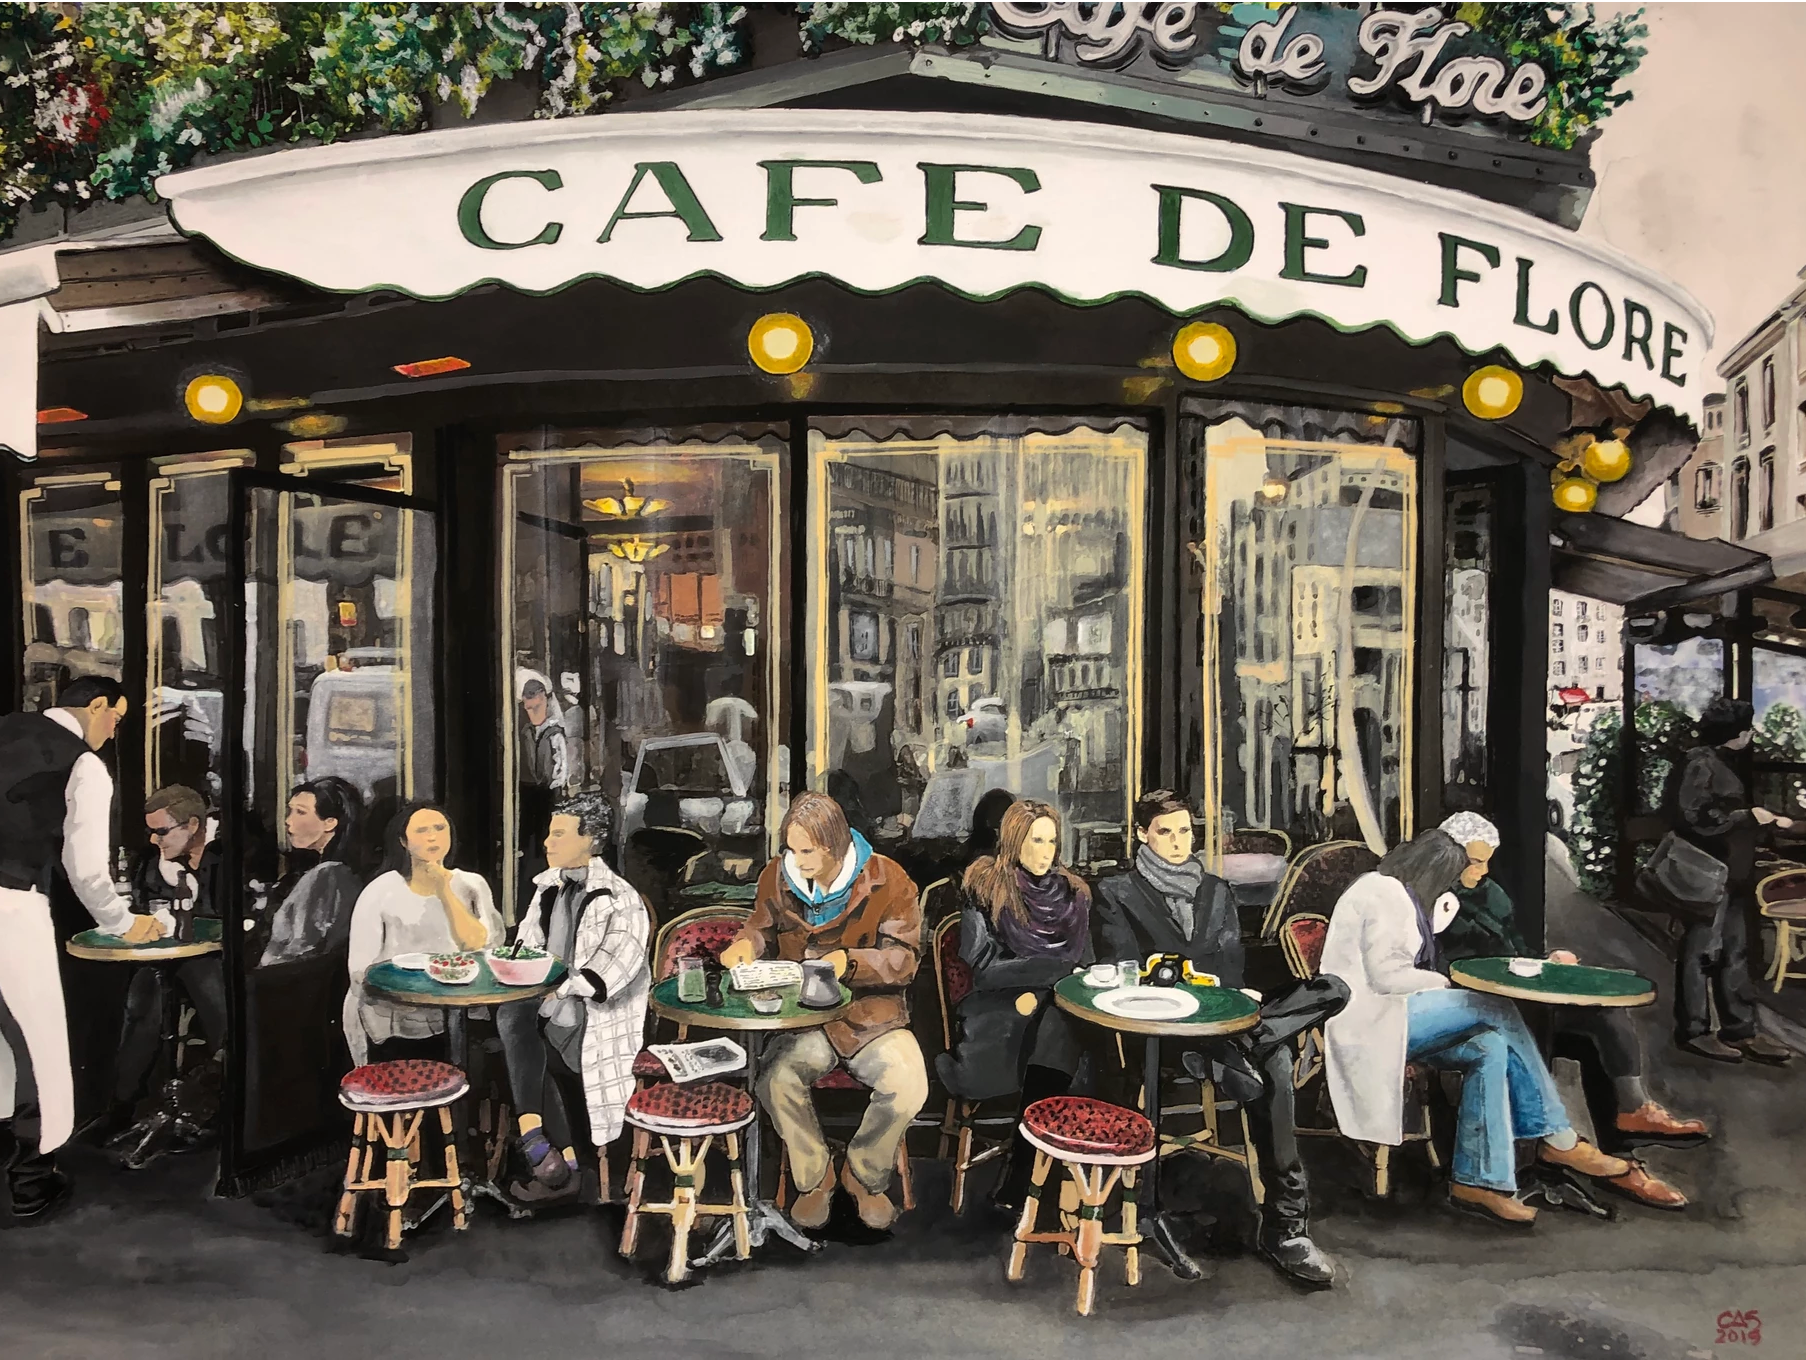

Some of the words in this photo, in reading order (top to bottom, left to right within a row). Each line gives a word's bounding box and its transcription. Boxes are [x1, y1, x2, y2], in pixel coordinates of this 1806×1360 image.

[1239, 5, 1325, 80] de
[1348, 7, 1548, 121] Flore
[456, 160, 1043, 252] CAFE
[1150, 183, 1368, 288] DE
[1437, 231, 1689, 387] FLORE
[1717, 1309, 1762, 1329] CAS
